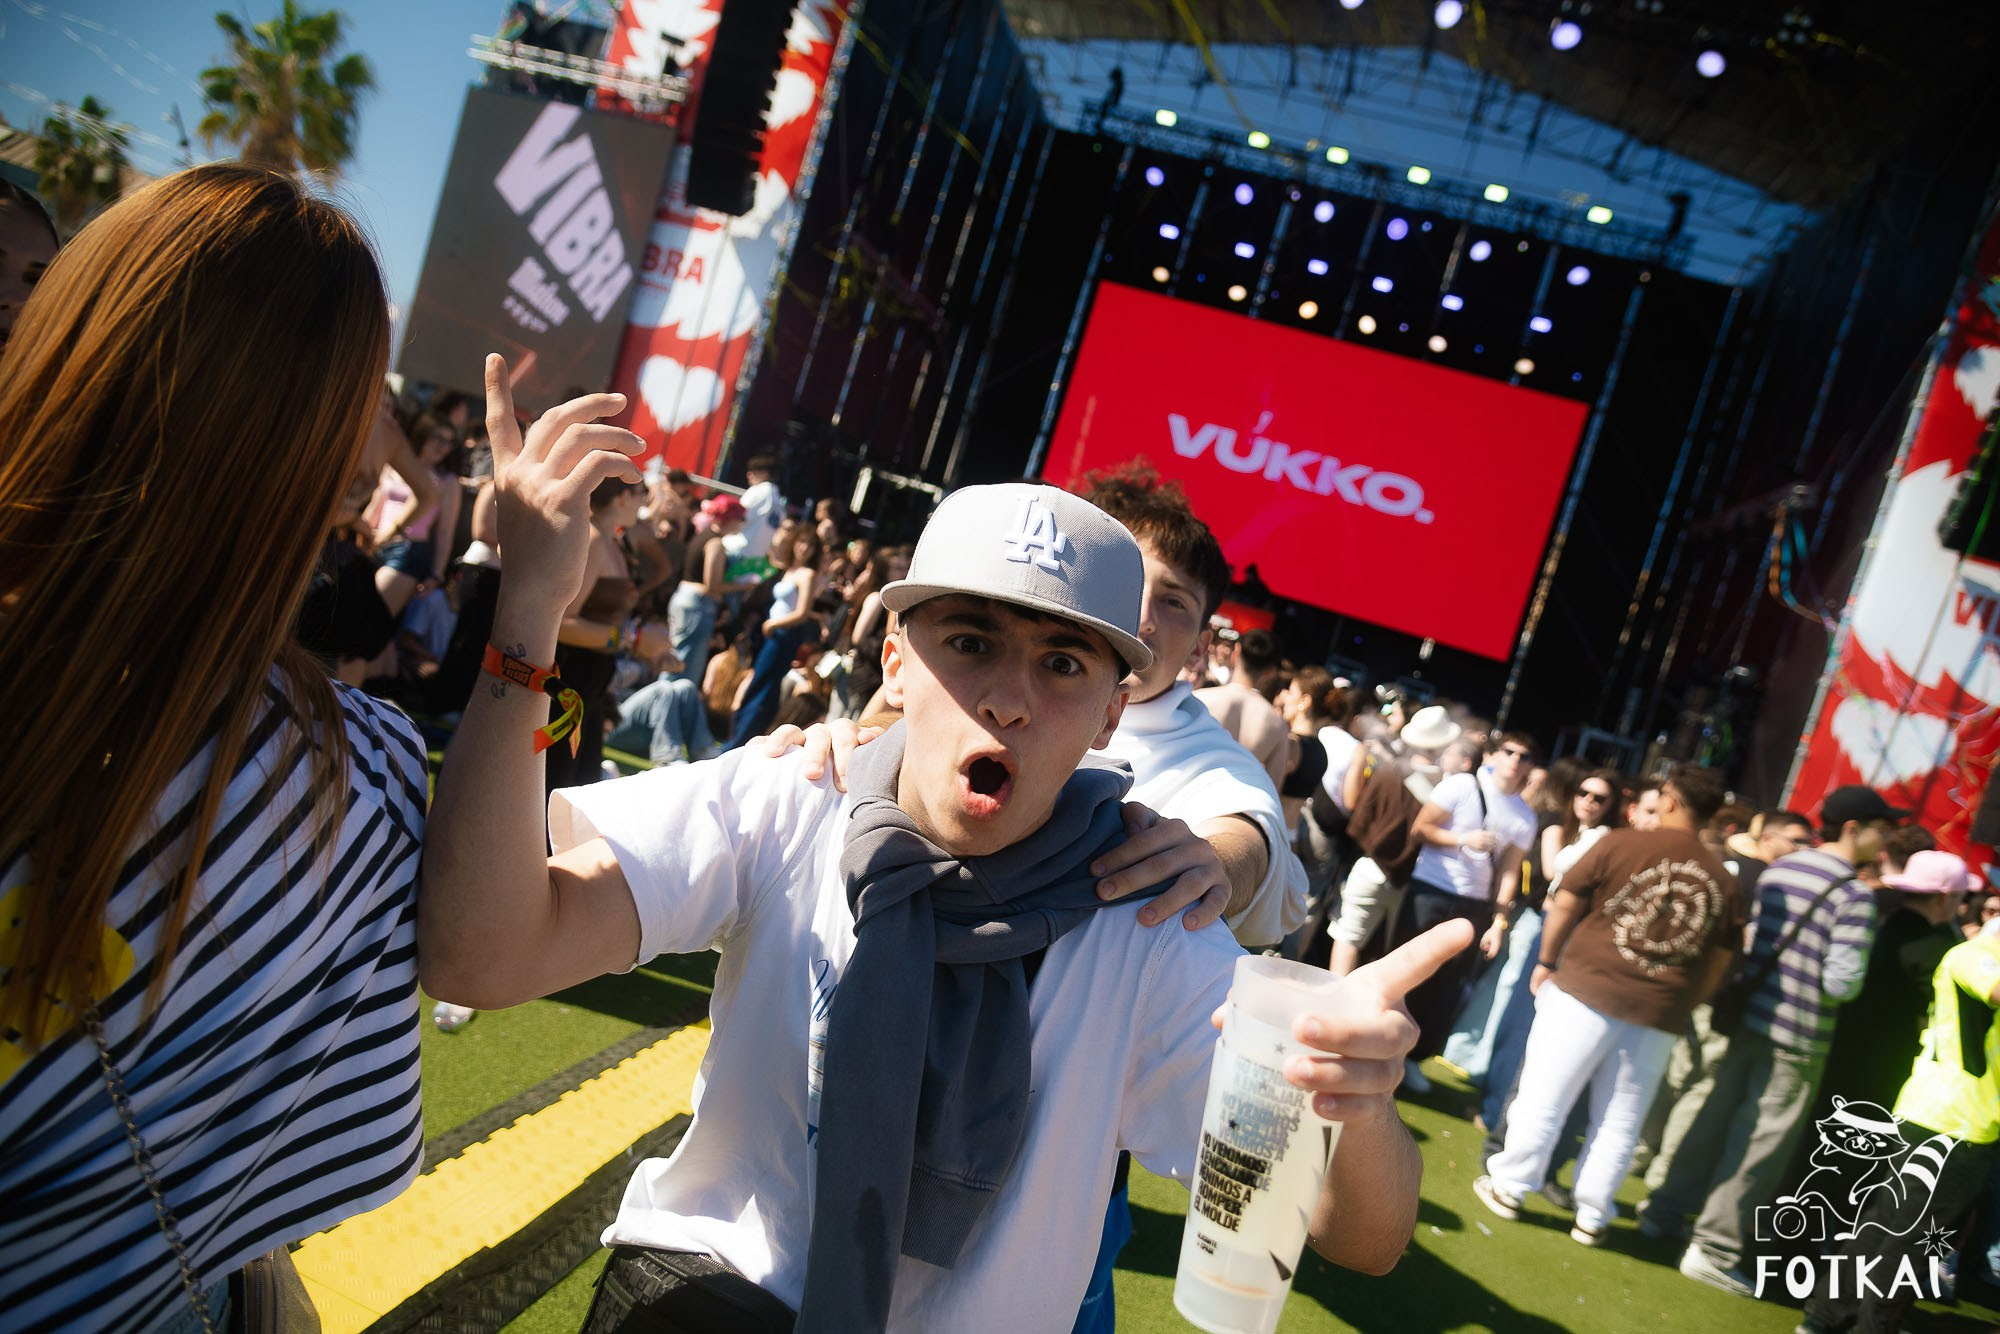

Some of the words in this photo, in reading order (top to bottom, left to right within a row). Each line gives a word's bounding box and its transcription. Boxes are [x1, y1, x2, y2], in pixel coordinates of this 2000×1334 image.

[494, 101, 633, 324] VIBRA
[641, 243, 704, 286] BRA
[1003, 496, 1067, 571] LA
[1200, 1200, 1242, 1233] MOLDE
[1243, 1187, 1253, 1204] A
